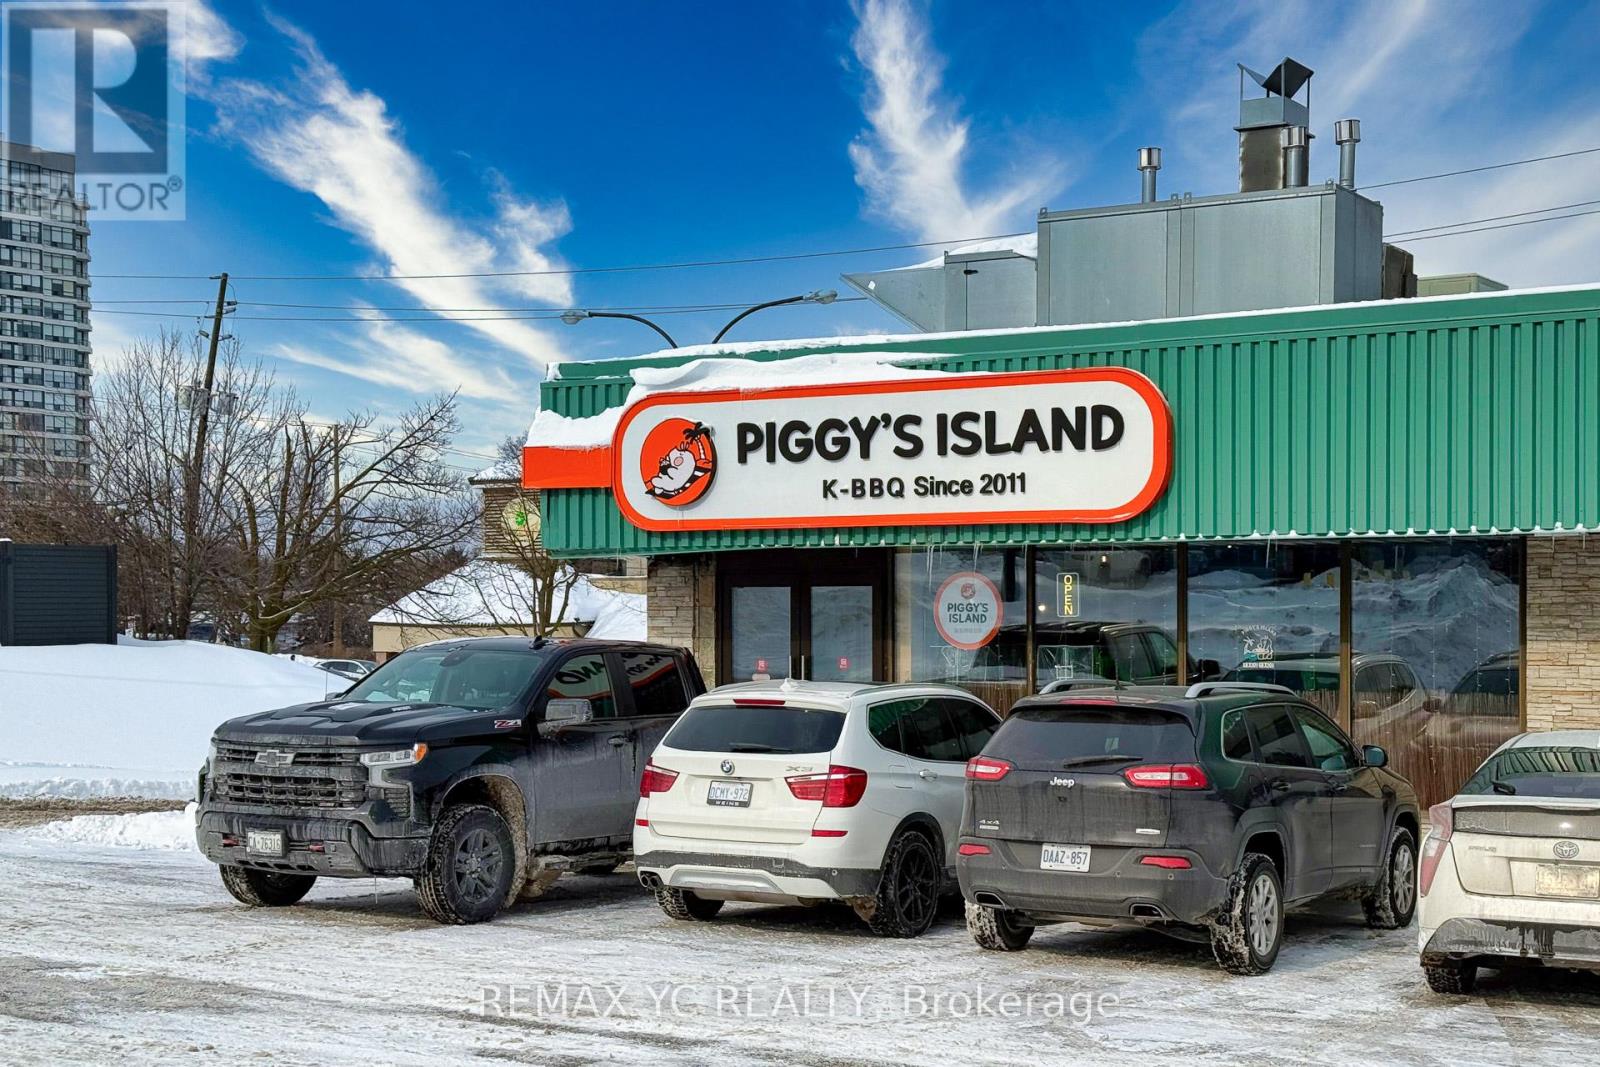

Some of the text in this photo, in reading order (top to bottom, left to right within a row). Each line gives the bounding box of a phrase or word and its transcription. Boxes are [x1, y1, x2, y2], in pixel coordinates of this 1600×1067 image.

[936, 404, 1125, 457] ISLAND
[822, 472, 1026, 500] K-BBQ Since 2011
[1063, 574, 1073, 615] OPEN
[948, 613, 987, 624] ISLAND
[1050, 776, 1075, 788] Jeep
